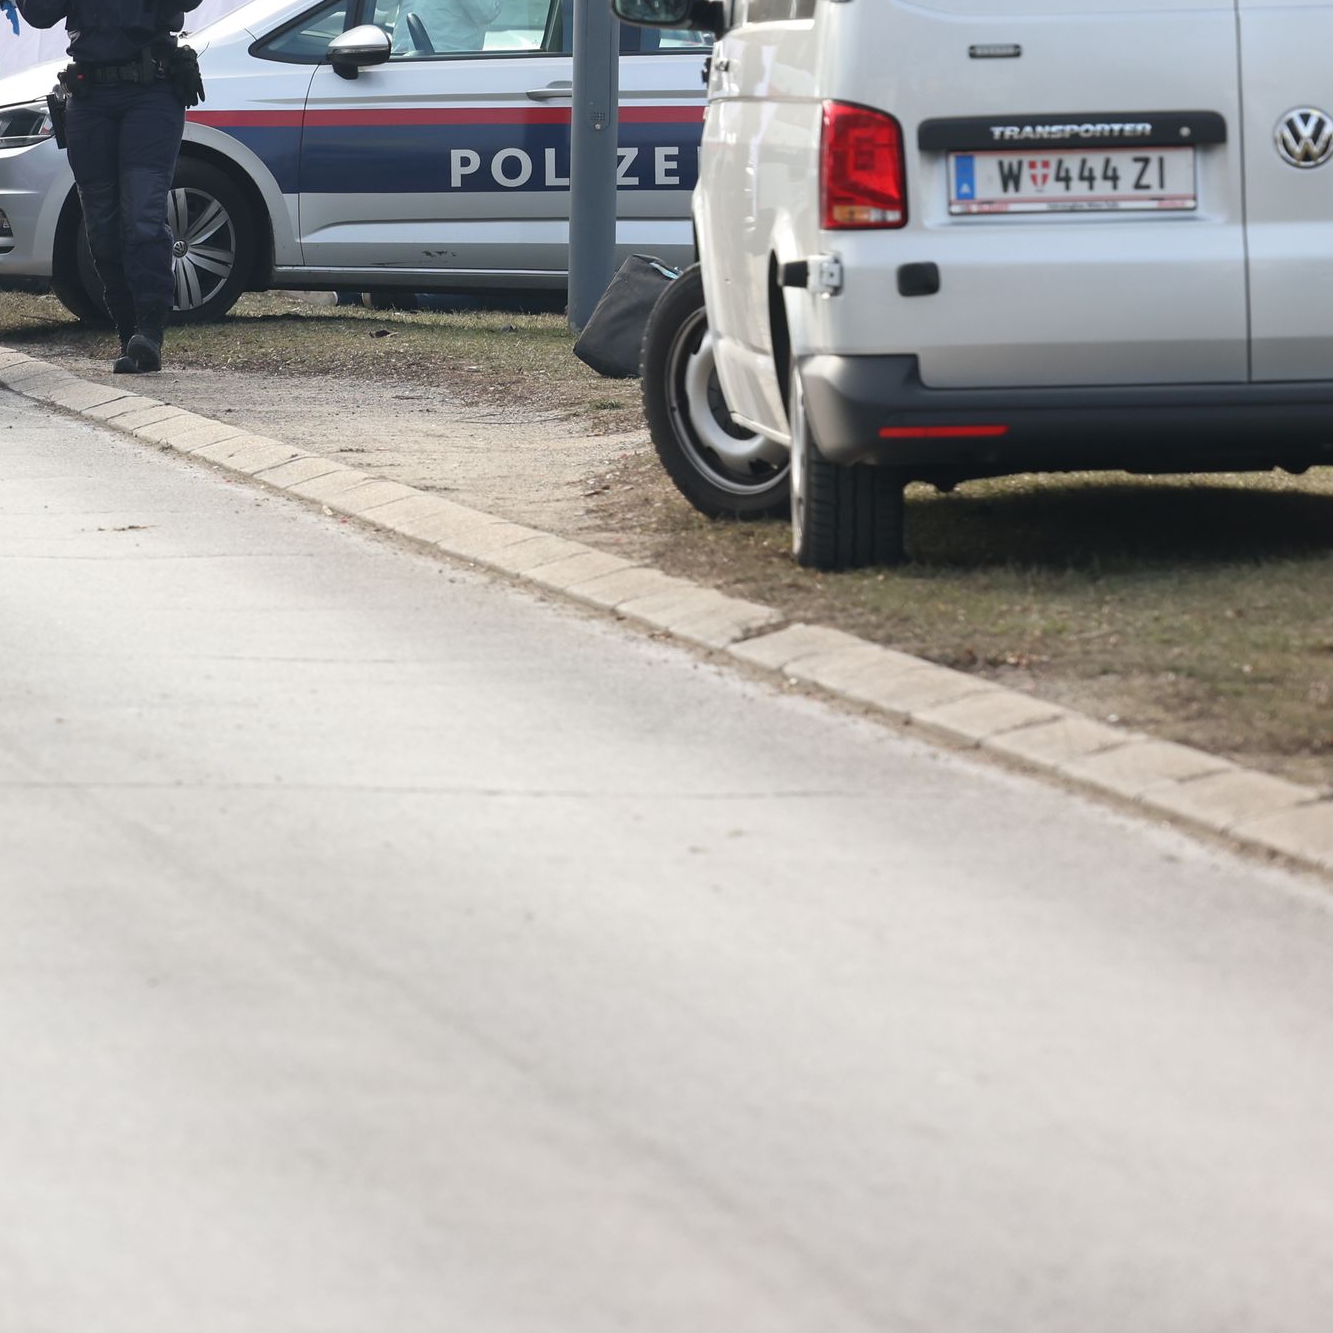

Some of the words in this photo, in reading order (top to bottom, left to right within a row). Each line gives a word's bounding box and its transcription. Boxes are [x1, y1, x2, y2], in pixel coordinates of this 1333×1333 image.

[990, 122, 1152, 140] TRANSPORTER
[450, 146, 702, 188] POLZE
[998, 159, 1023, 193] W
[1054, 157, 1120, 191] 444
